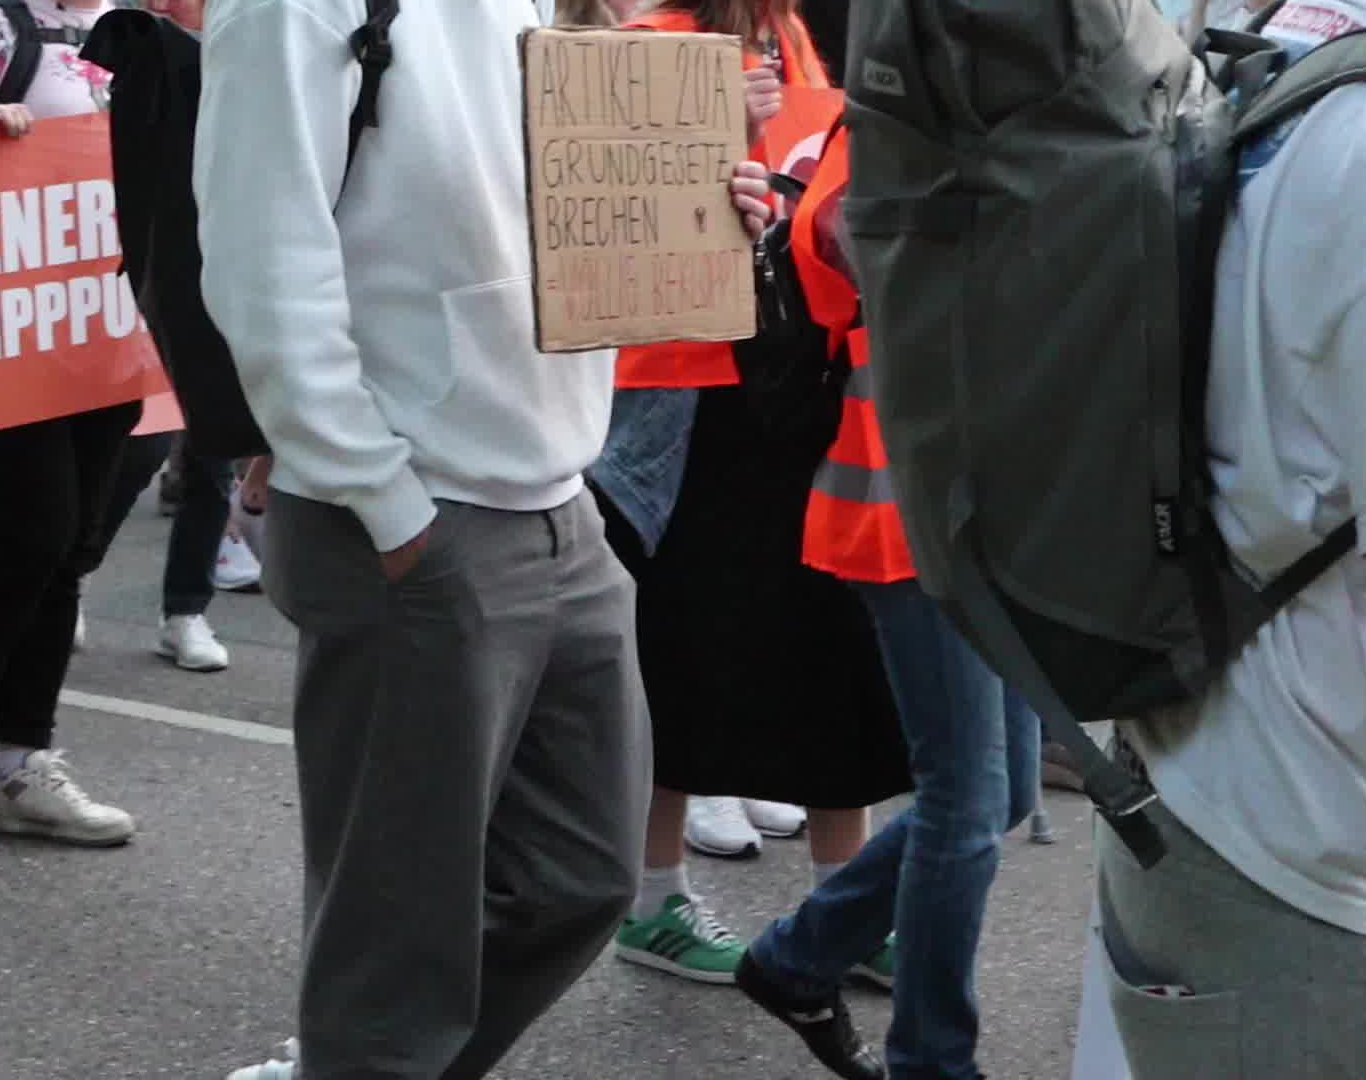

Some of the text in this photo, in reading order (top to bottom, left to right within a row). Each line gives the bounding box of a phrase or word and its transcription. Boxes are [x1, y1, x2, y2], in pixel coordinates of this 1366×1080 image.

[539, 39, 732, 132] ARTIKEL 20A
[542, 139, 732, 189] GRUNDGESETZ
[545, 195, 660, 251] BRECHEN
